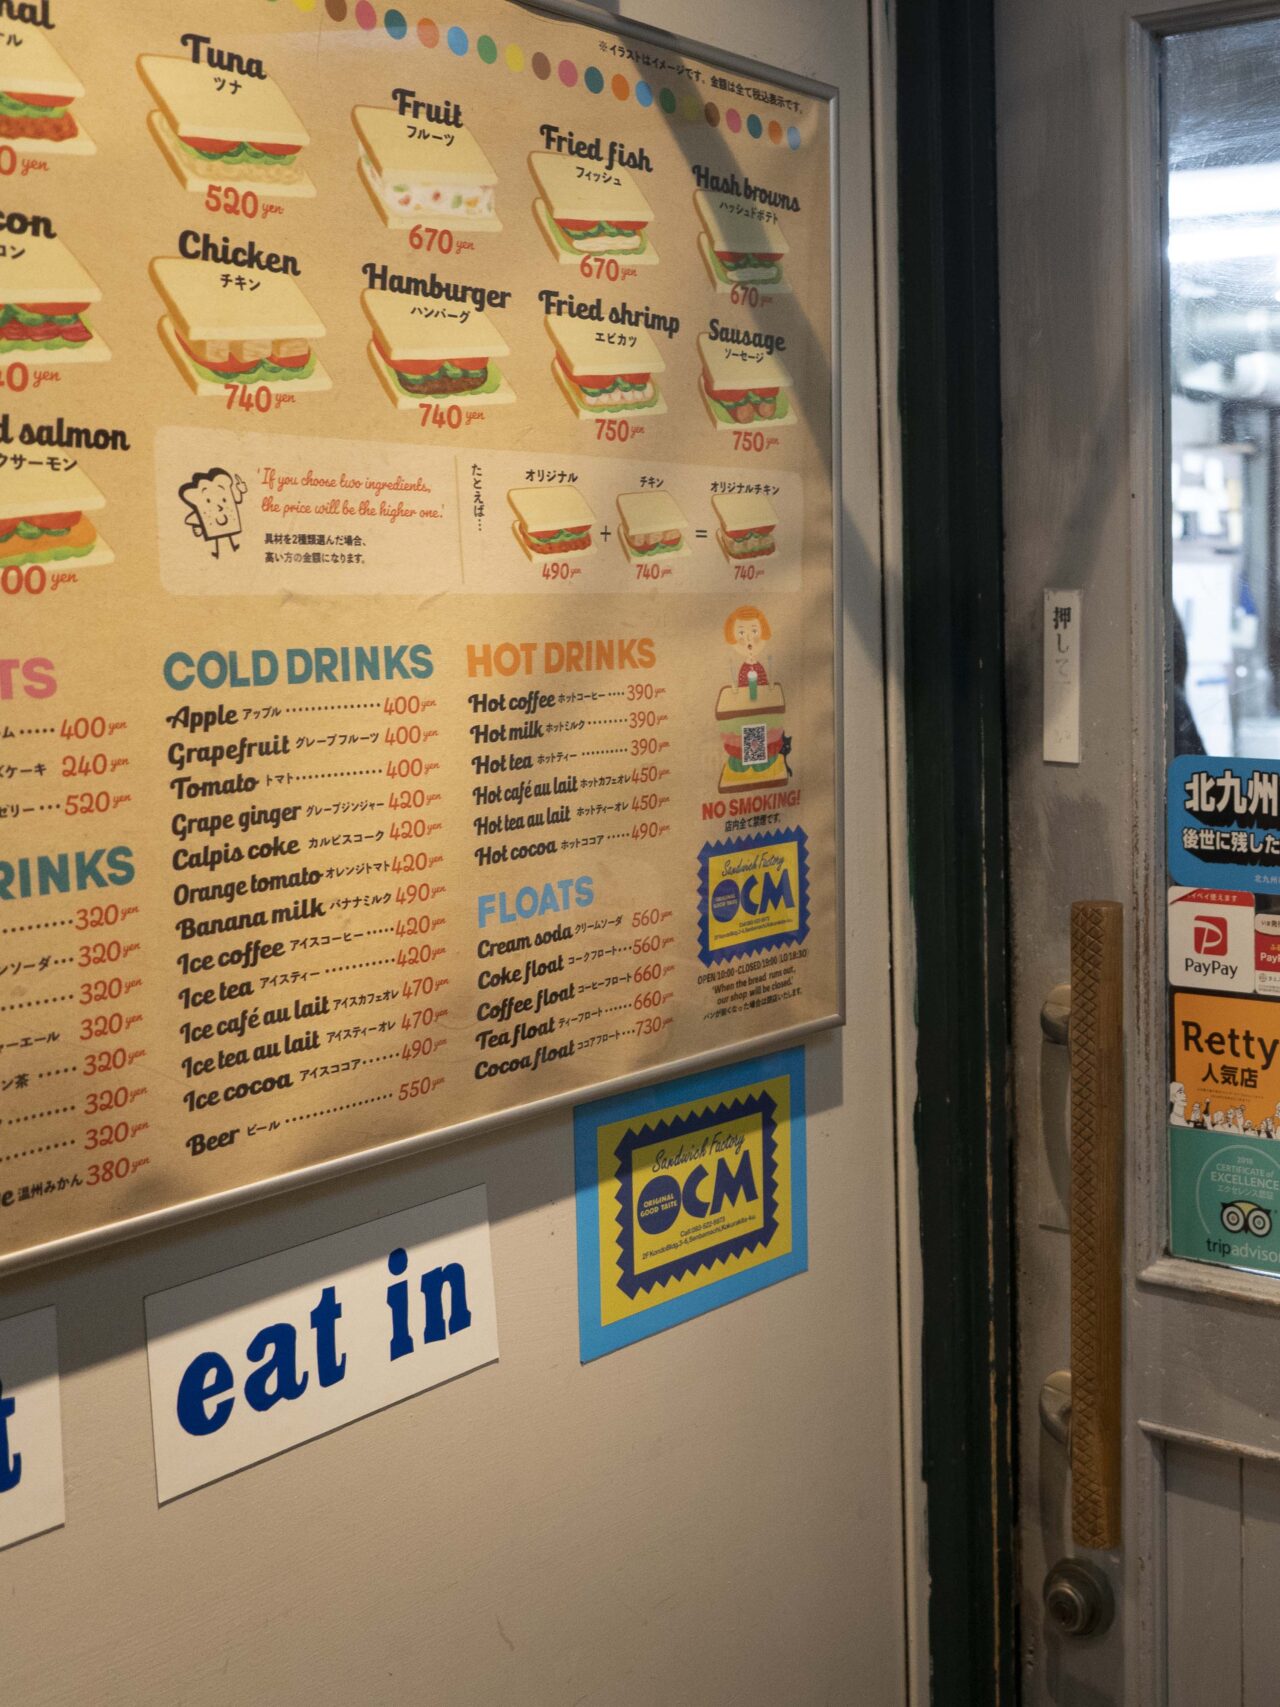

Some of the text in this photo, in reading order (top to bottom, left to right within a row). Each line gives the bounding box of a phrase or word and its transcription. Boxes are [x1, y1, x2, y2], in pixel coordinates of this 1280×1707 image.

[180, 33, 267, 80] Tuna
[213, 77, 243, 95] ツナ
[392, 88, 464, 129] Fruit
[406, 125, 455, 147] フルーツ
[540, 123, 654, 173] Fried fish
[576, 166, 622, 187] フィッシュ
[692, 164, 801, 212] Hash browns
[205, 184, 285, 218] 520 yen
[719, 200, 779, 226] ハッシュドポテト
[179, 230, 302, 278] Chicken
[409, 223, 453, 254] 670
[220, 273, 261, 292] チキン
[362, 262, 512, 311] Hamburger
[730, 282, 759, 309] 670
[411, 305, 471, 325] ハンバーグ
[538, 289, 680, 338] Fried shrimp
[595, 330, 638, 348] エビカツ
[708, 318, 787, 354] Sausage
[724, 347, 765, 364] ソーセージ
[224, 383, 272, 413] 740
[19, 418, 131, 452] salmon
[733, 430, 764, 453] 750
[278, 475, 299, 492] you
[301, 470, 336, 488] choose
[340, 473, 363, 489] two
[365, 476, 431, 496] ingredients,
[710, 480, 780, 497] オリジナルチキン
[261, 496, 281, 513] the
[283, 501, 312, 518] price
[315, 499, 340, 515] will
[342, 500, 356, 515] be
[358, 501, 377, 516] the
[379, 501, 417, 523] higher
[163, 644, 435, 692] COLD DRINKS
[467, 638, 657, 678] HOT DRINKS
[166, 695, 420, 733] Apple アップル 400
[468, 690, 556, 714] Hot coffee
[470, 719, 585, 744] Hot milk ホットミルク
[168, 734, 290, 771] Grapefruit
[170, 775, 260, 800] Tomato
[472, 784, 503, 807] Hot
[503, 776, 533, 804] café
[534, 780, 553, 796] au
[553, 774, 578, 795] lait
[702, 789, 801, 820] NO SMOKING!
[171, 804, 302, 841] Grape ginger
[172, 829, 385, 871] Calpis coke カルピスコーク
[175, 883, 430, 940] Banana milk バナナミルク 490
[477, 875, 595, 929] FLOATS
[711, 868, 795, 923] OCM
[1187, 892, 1238, 903] イペイ使えます
[177, 941, 286, 976] Ice coffee
[477, 923, 574, 960] Cream soda
[477, 954, 564, 990] Coke float
[1185, 957, 1238, 979] PayPay
[179, 995, 330, 1045] Ice café au lait
[1182, 1020, 1280, 1070] Retty
[1201, 1062, 1259, 1089] 人気店
[186, 1075, 431, 1156] Beer ビール 550
[652, 1131, 744, 1173] Sandwich Factory
[18, 1158, 130, 1202] 温州みかん 380
[1210, 1171, 1280, 1190] EXCELLENCE
[1216, 1163, 1264, 1177] CERTIFICATE
[637, 1149, 759, 1235] OCM
[643, 1193, 674, 1208] ORIGINAL
[640, 1206, 659, 1218] GOOD
[176, 1285, 347, 1437] eat
[387, 1247, 472, 1362] in
